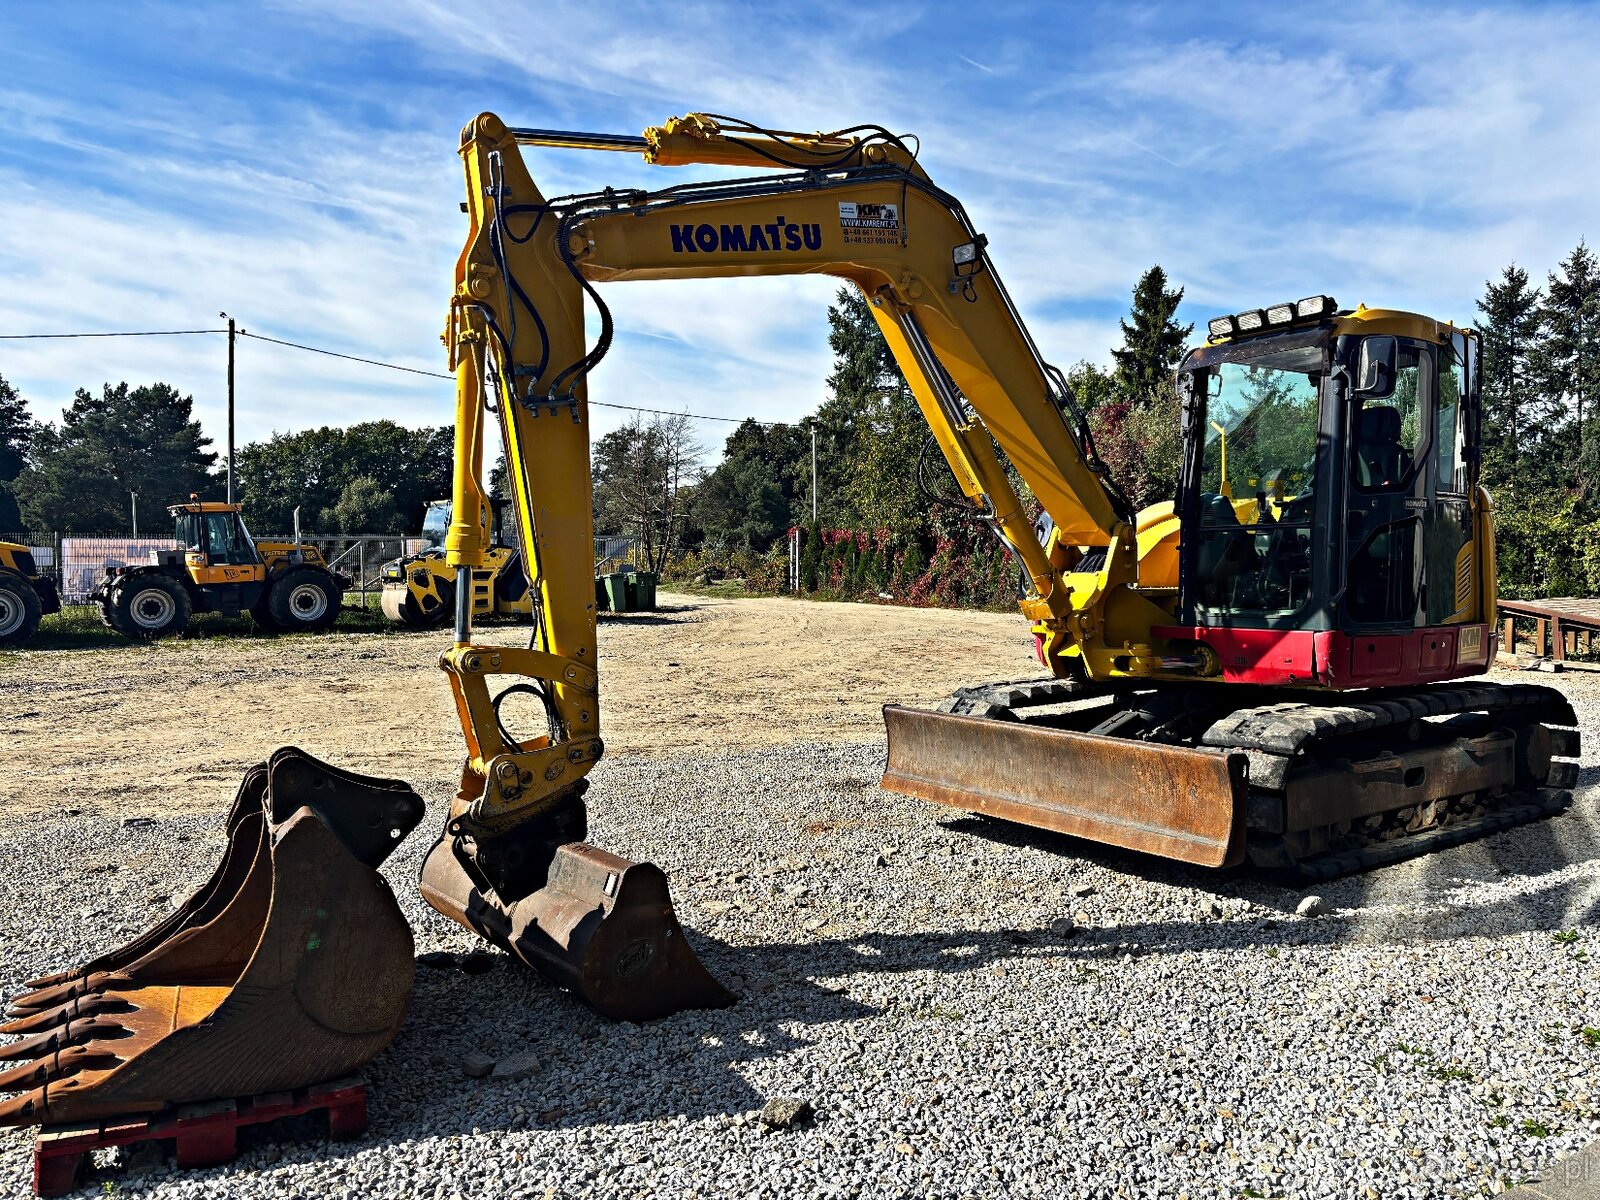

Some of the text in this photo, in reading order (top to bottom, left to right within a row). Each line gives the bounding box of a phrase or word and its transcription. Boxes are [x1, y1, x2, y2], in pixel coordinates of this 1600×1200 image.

[857, 204, 880, 216] KM
[841, 219, 899, 228] WWW.KMRENT.PL
[670, 216, 822, 252] KOMATSU
